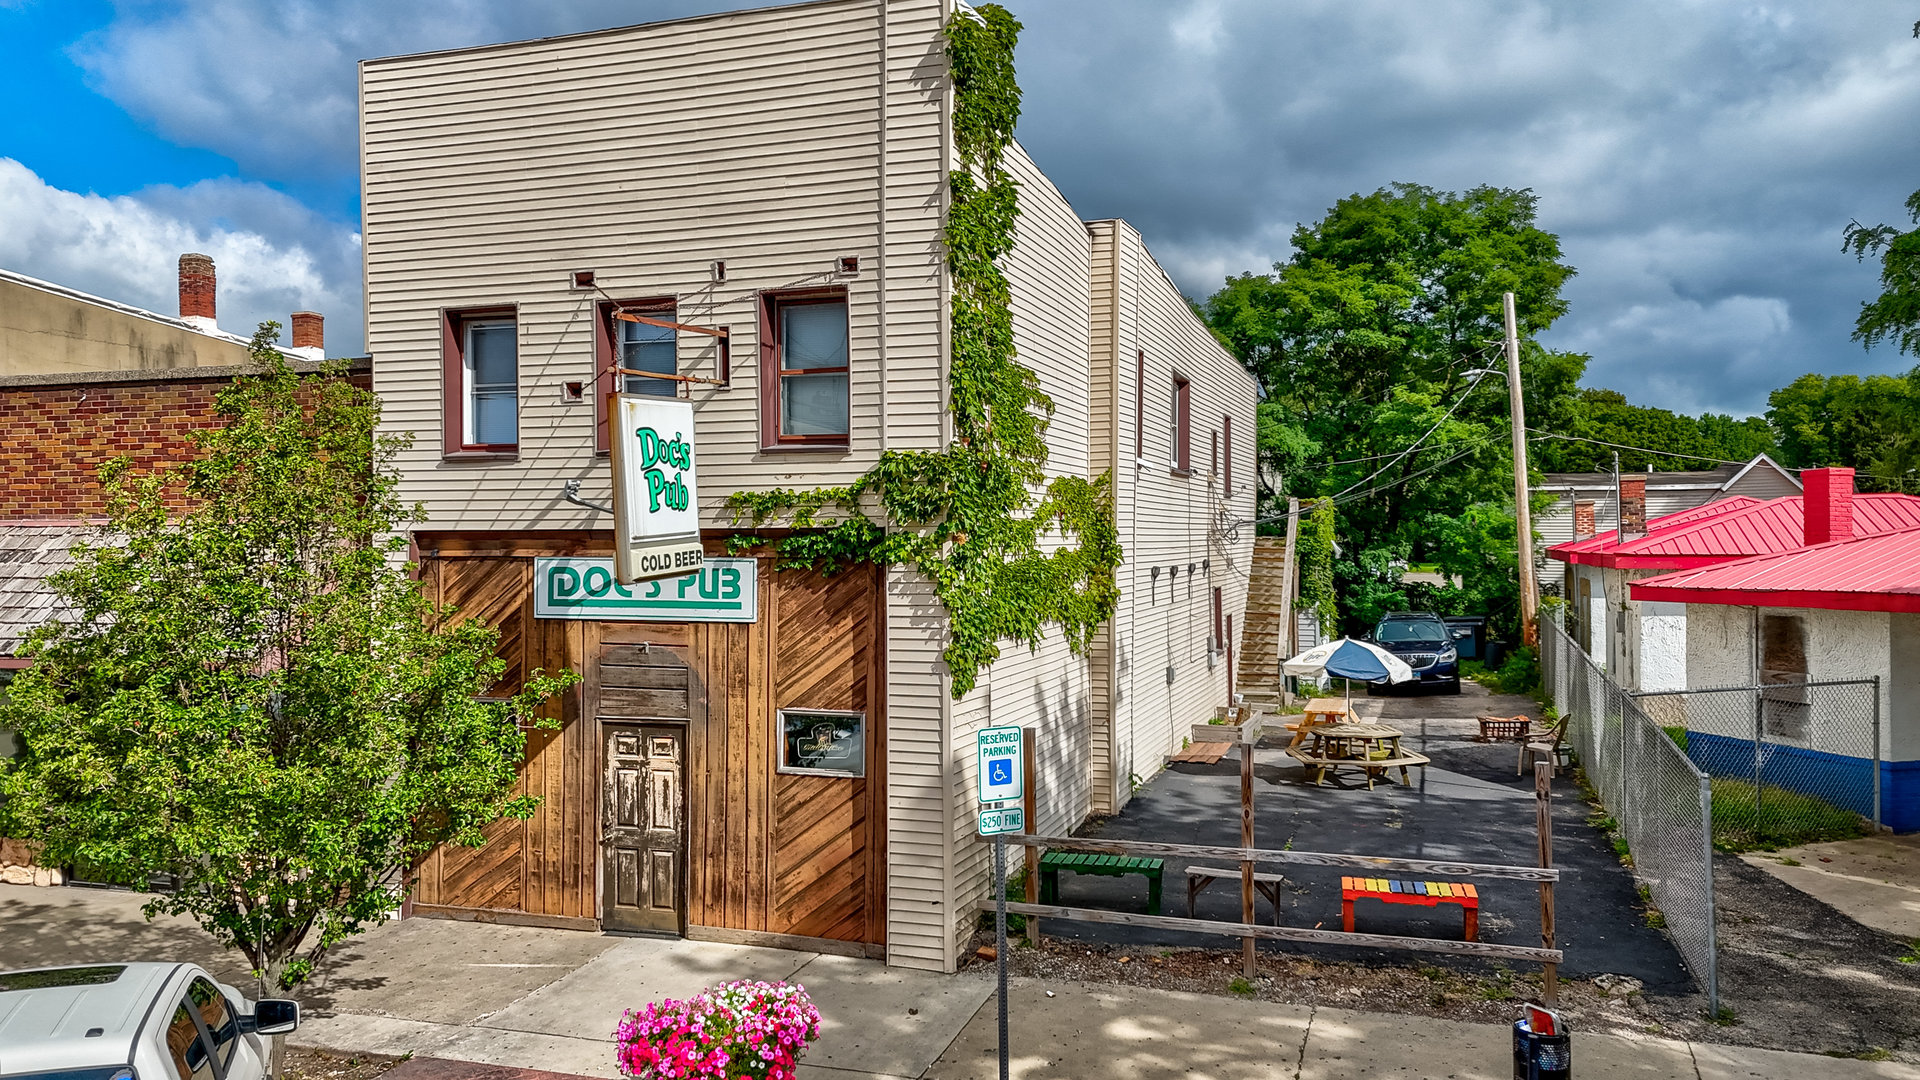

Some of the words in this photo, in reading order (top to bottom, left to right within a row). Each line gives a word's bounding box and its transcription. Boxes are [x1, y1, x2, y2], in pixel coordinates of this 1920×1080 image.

[636, 427, 690, 471] Doc's
[644, 468, 689, 513] Pub
[641, 553, 672, 573] COLD
[674, 549, 703, 568] BEER
[548, 566, 661, 598] DOS
[678, 568, 741, 599] PUB
[980, 732, 1018, 745] RESERVED
[983, 745, 1017, 757] PARKING
[982, 815, 1001, 828] $250
[1005, 813, 1020, 826] FINE
